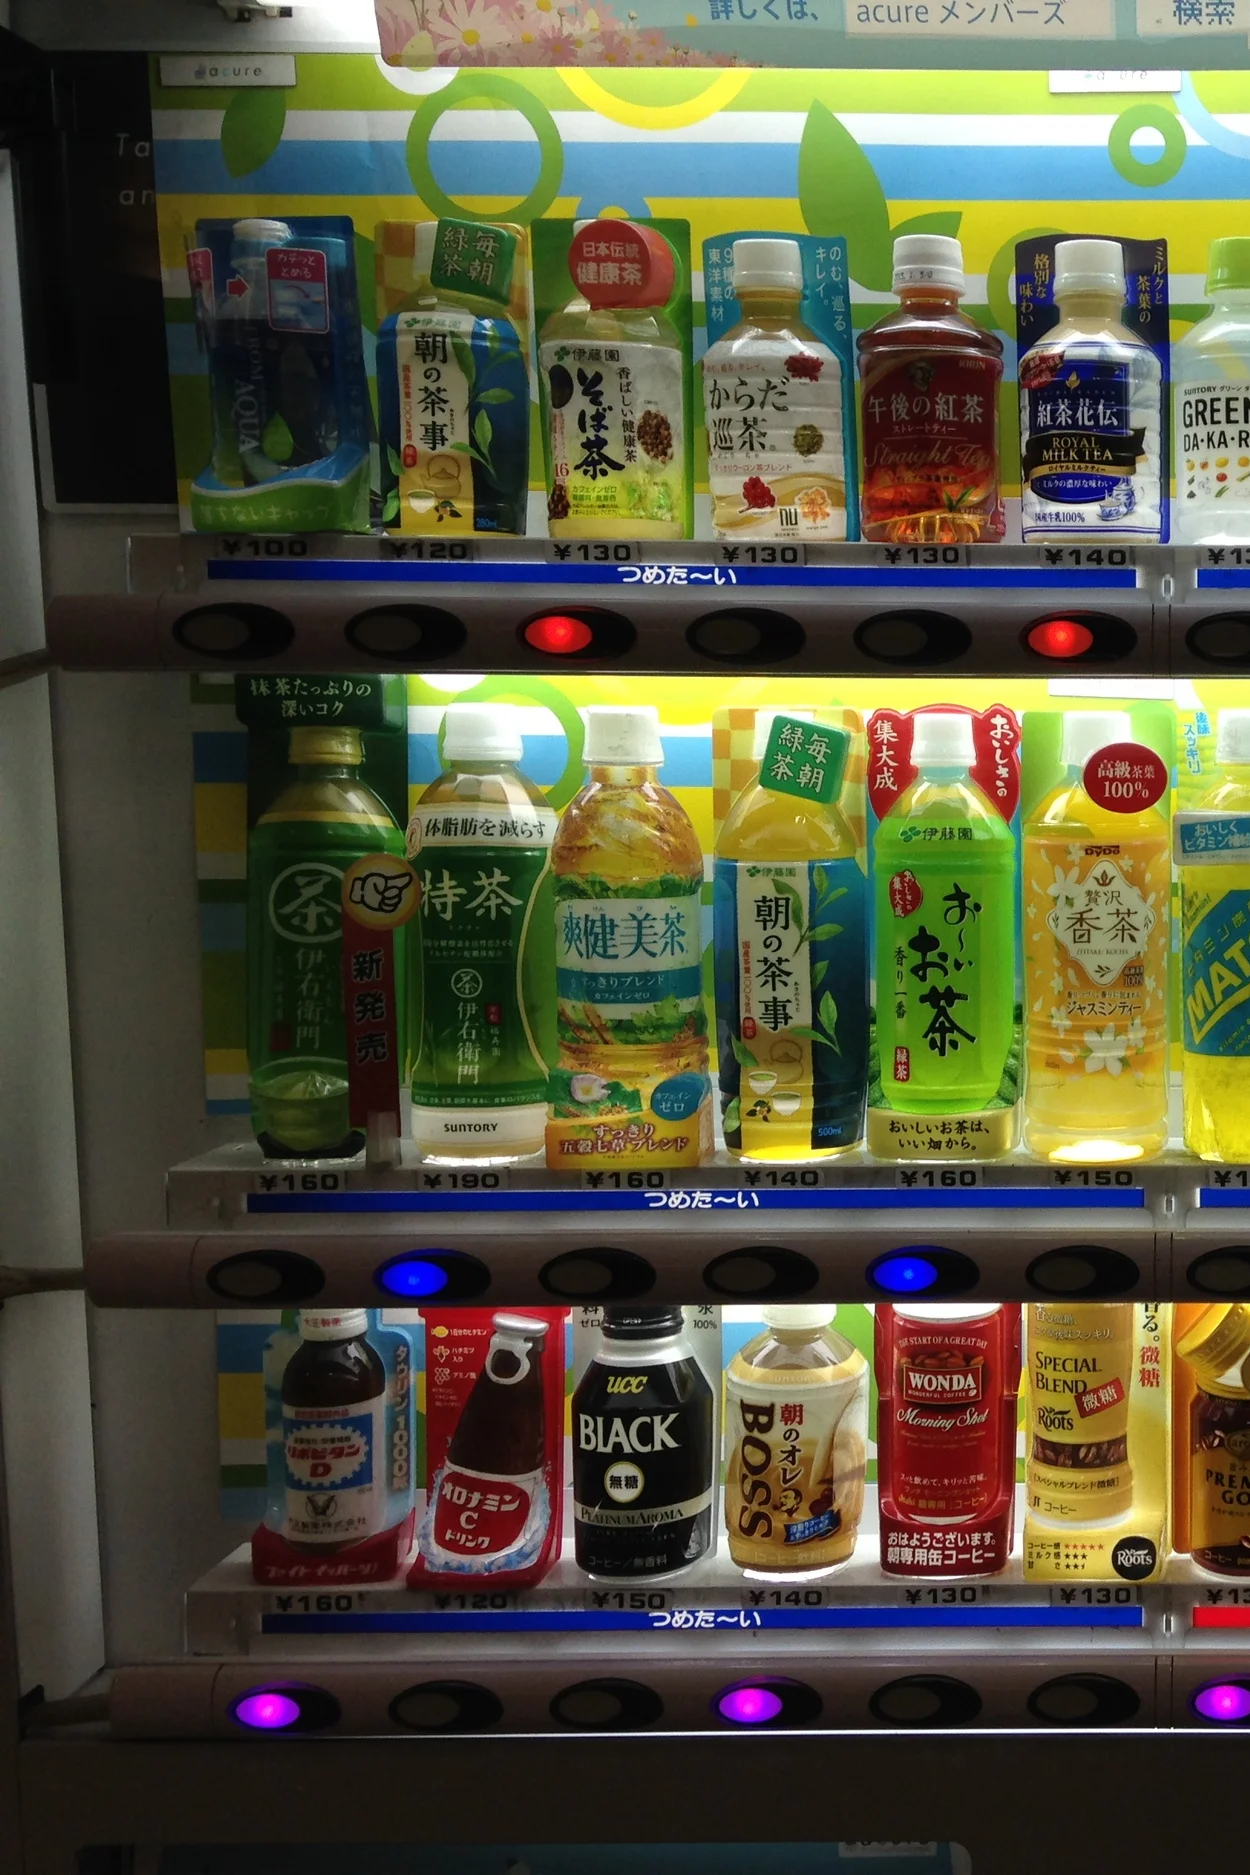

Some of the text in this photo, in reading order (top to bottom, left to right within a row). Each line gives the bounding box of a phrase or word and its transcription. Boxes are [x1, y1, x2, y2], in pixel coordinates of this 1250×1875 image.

[856, 2, 929, 23] acure
[1173, 0, 1236, 25] 検索
[576, 261, 643, 288] 健康茶
[706, 248, 726, 323] 東洋素材
[958, 358, 987, 371] KIRIN
[413, 331, 451, 451] 朝の茶事
[708, 374, 791, 413] からだ
[1183, 386, 1217, 396] SUNTORY
[867, 393, 985, 425] 午後の紅茶
[1035, 400, 1120, 428] 紅茶花伝
[711, 416, 768, 452] 巡茶
[892, 424, 957, 435] ストレートティー
[1051, 436, 1101, 451] ROYAL
[1041, 448, 1114, 463] MILK TEA
[221, 538, 309, 558] ¥100
[388, 540, 468, 561] ¥120
[552, 543, 632, 562] ¥130
[721, 545, 799, 565] ¥130
[884, 546, 960, 565] ¥130
[1044, 547, 1127, 567] ¥140
[250, 677, 373, 698] 抹茶たっぷりの
[280, 699, 345, 718] 深いコク
[873, 719, 899, 792] 集大成
[1096, 760, 1156, 779] 高級茶葉
[424, 816, 547, 839] 体脂肪を減らす
[922, 827, 973, 841] 伊藤園
[419, 866, 525, 922] 特茶
[562, 911, 689, 962] 爽健美茶
[1064, 908, 1141, 945] 香茶
[753, 895, 794, 1032] 朝の茶事
[351, 947, 390, 1065] 新発売
[1065, 1000, 1143, 1018] ジャスミンティー
[658, 1101, 686, 1114] ゼロ
[443, 1122, 499, 1134] SUNTORY
[817, 1125, 842, 1137] 500ml
[888, 1119, 991, 1136] おいしいお茶は、
[259, 1172, 339, 1192] ¥160
[423, 1172, 500, 1189] ¥190
[585, 1170, 665, 1189] ¥160
[744, 1169, 819, 1187] ¥140
[900, 1169, 977, 1188] ¥160
[1054, 1169, 1134, 1187] ¥150
[692, 1320, 718, 1330] 100%
[908, 1336, 934, 1347] START
[948, 1337, 976, 1348] GREAT
[975, 1339, 989, 1349] DAY
[1035, 1351, 1103, 1374] SPECIAL
[908, 1371, 976, 1392] WONDA
[1035, 1371, 1088, 1395] BLEND
[942, 1390, 967, 1398] COFFEE
[896, 1406, 989, 1432] Morning Shot
[578, 1411, 683, 1455] BLACK
[286, 1445, 362, 1462] リポビタン
[777, 1403, 805, 1486] 朝のオレ
[738, 1398, 775, 1540] BOSS
[441, 1481, 522, 1513] オロナミン
[1043, 1503, 1077, 1516] コーヒー
[444, 1529, 491, 1550] ドリンク
[887, 1531, 996, 1547] おはようございます。
[886, 1547, 996, 1567] 朝専用缶コーヒー
[1204, 1551, 1233, 1564] コーヒー
[274, 1594, 353, 1613] ¥160
[433, 1591, 508, 1611] ¥120
[591, 1591, 666, 1610] ¥150
[749, 1589, 823, 1606] ¥140
[904, 1586, 977, 1604] ¥130
[1060, 1586, 1131, 1604] ¥130
